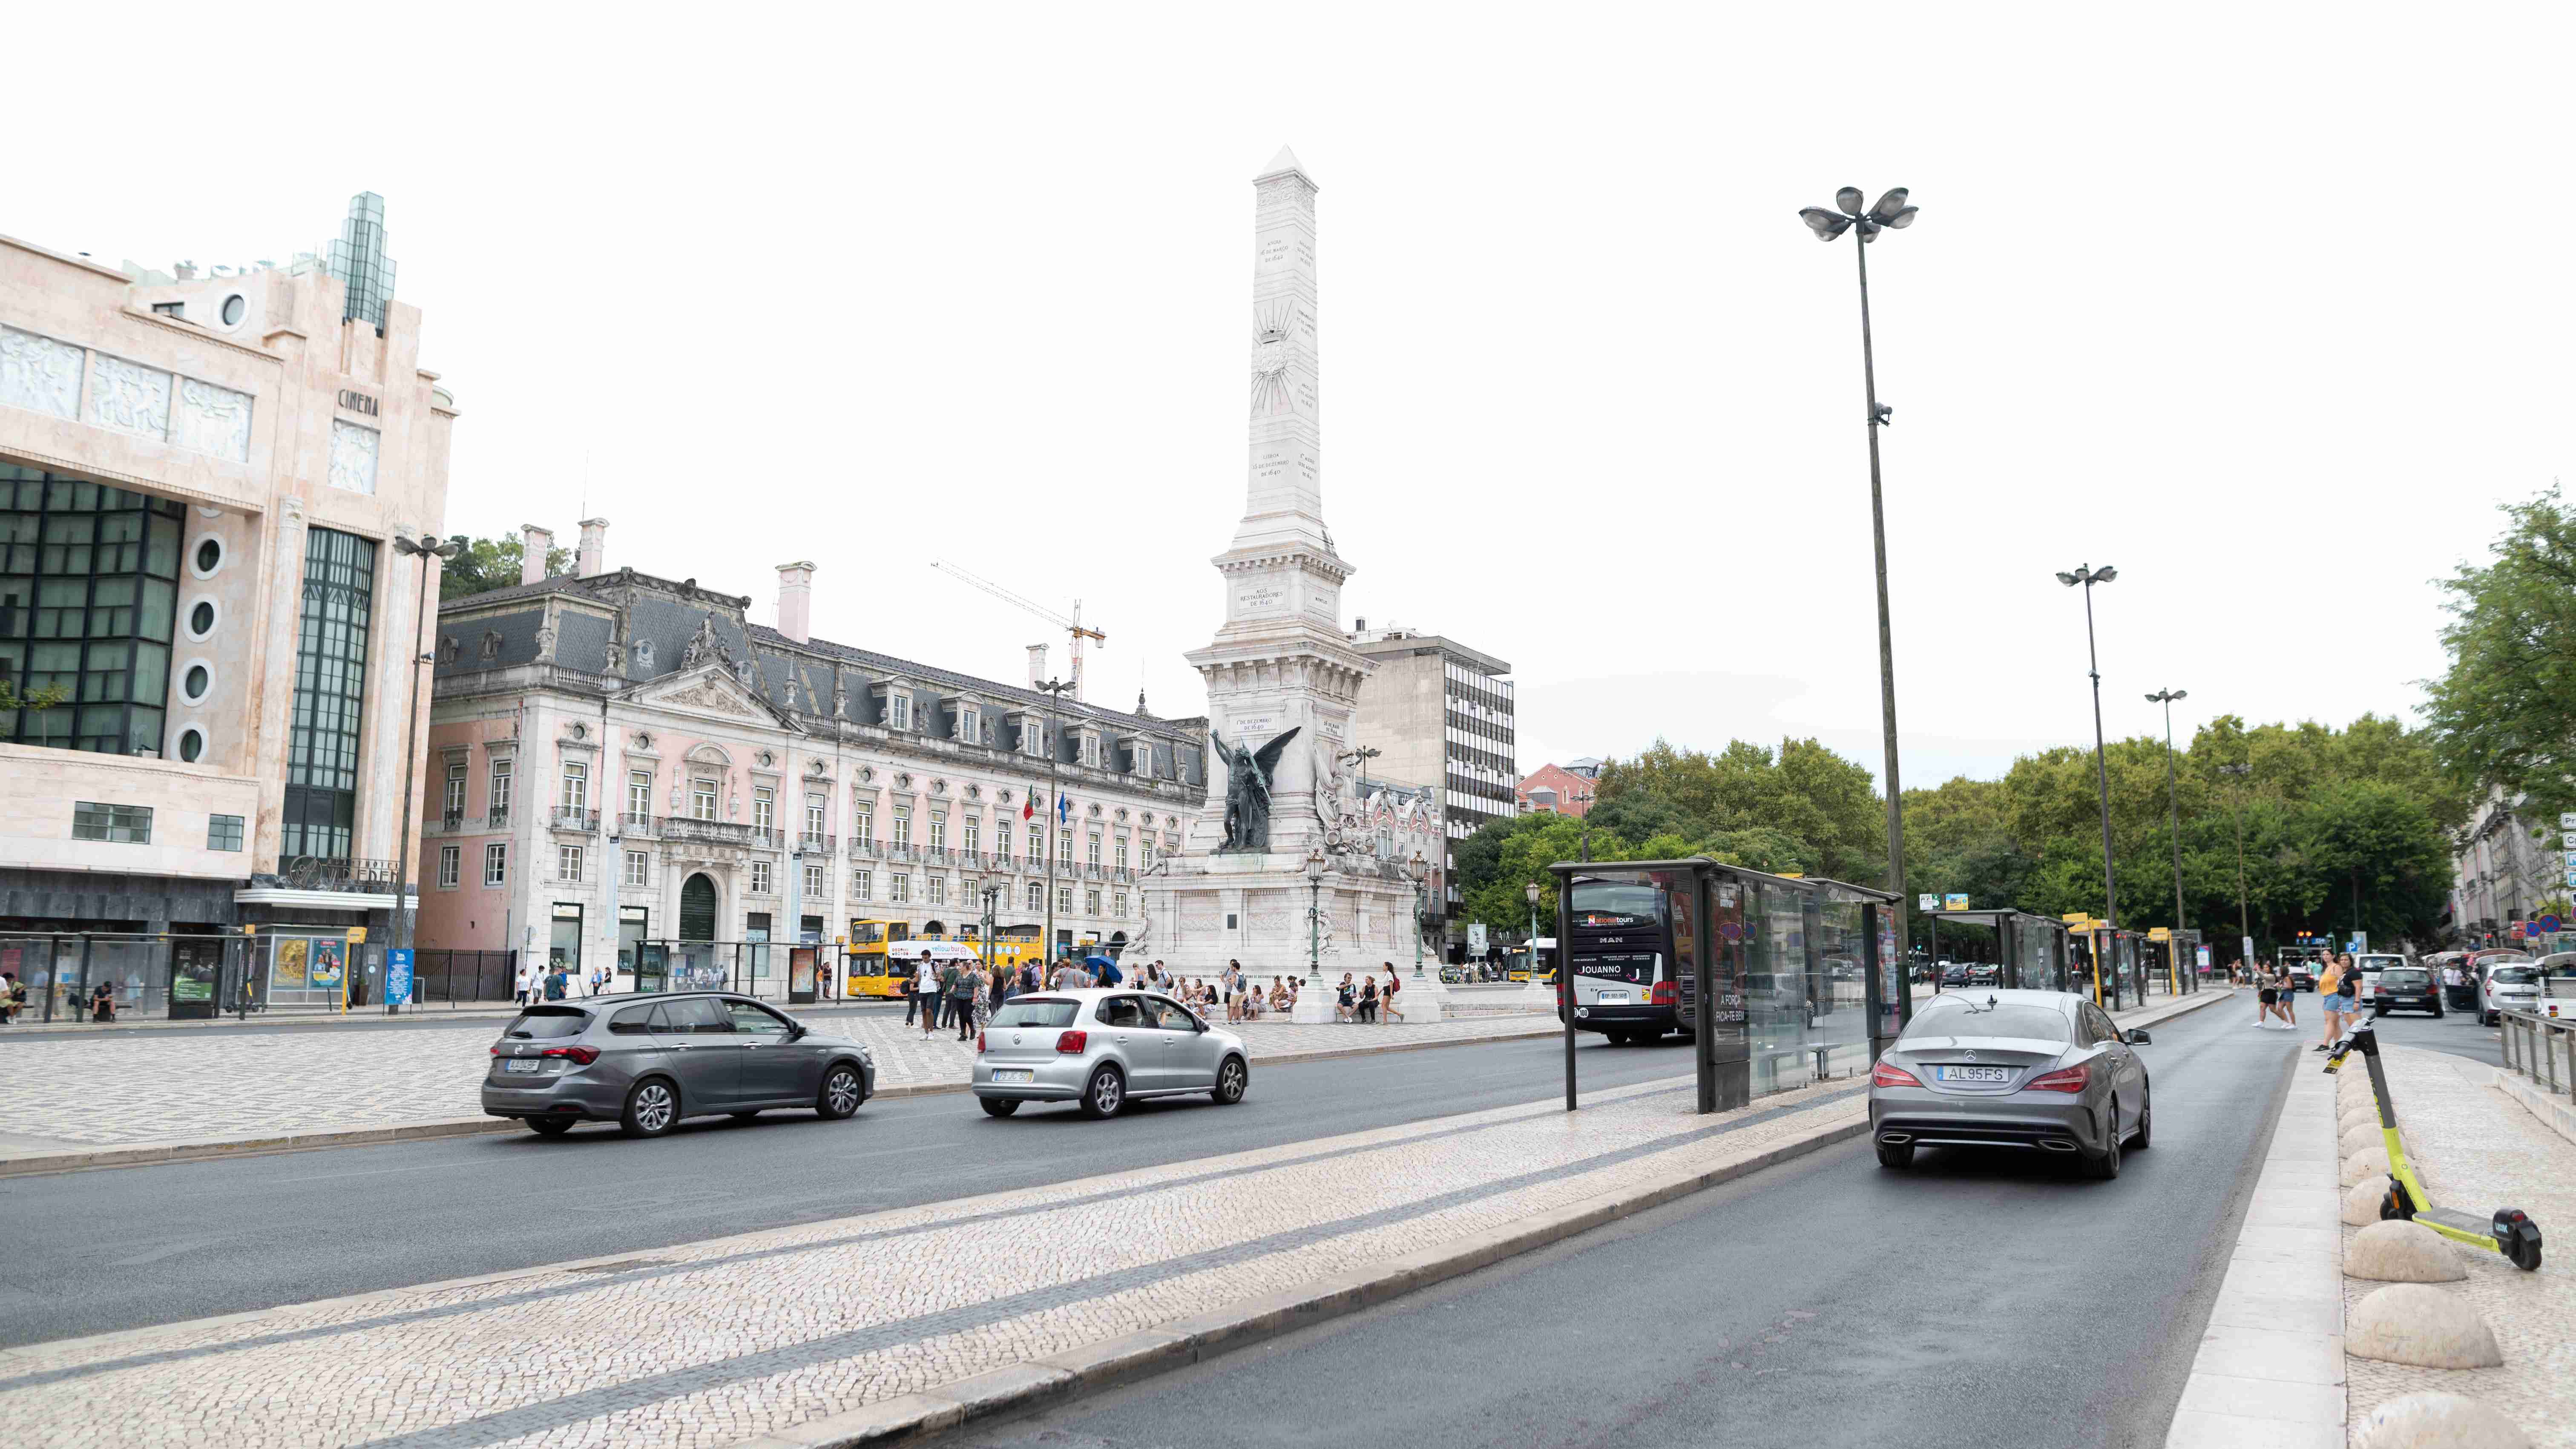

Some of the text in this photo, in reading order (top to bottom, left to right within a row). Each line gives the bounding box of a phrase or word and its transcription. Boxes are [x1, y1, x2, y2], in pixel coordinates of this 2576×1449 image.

[339, 389, 377, 417] CINEMA
[1240, 591, 1283, 601] RESTAURADORES
[357, 868, 399, 886] EDEN
[1579, 965, 1621, 974] JOUANNO
[1721, 995, 1741, 1008] A FORÇA
[1716, 1010, 1744, 1022] FICA-TE BEM
